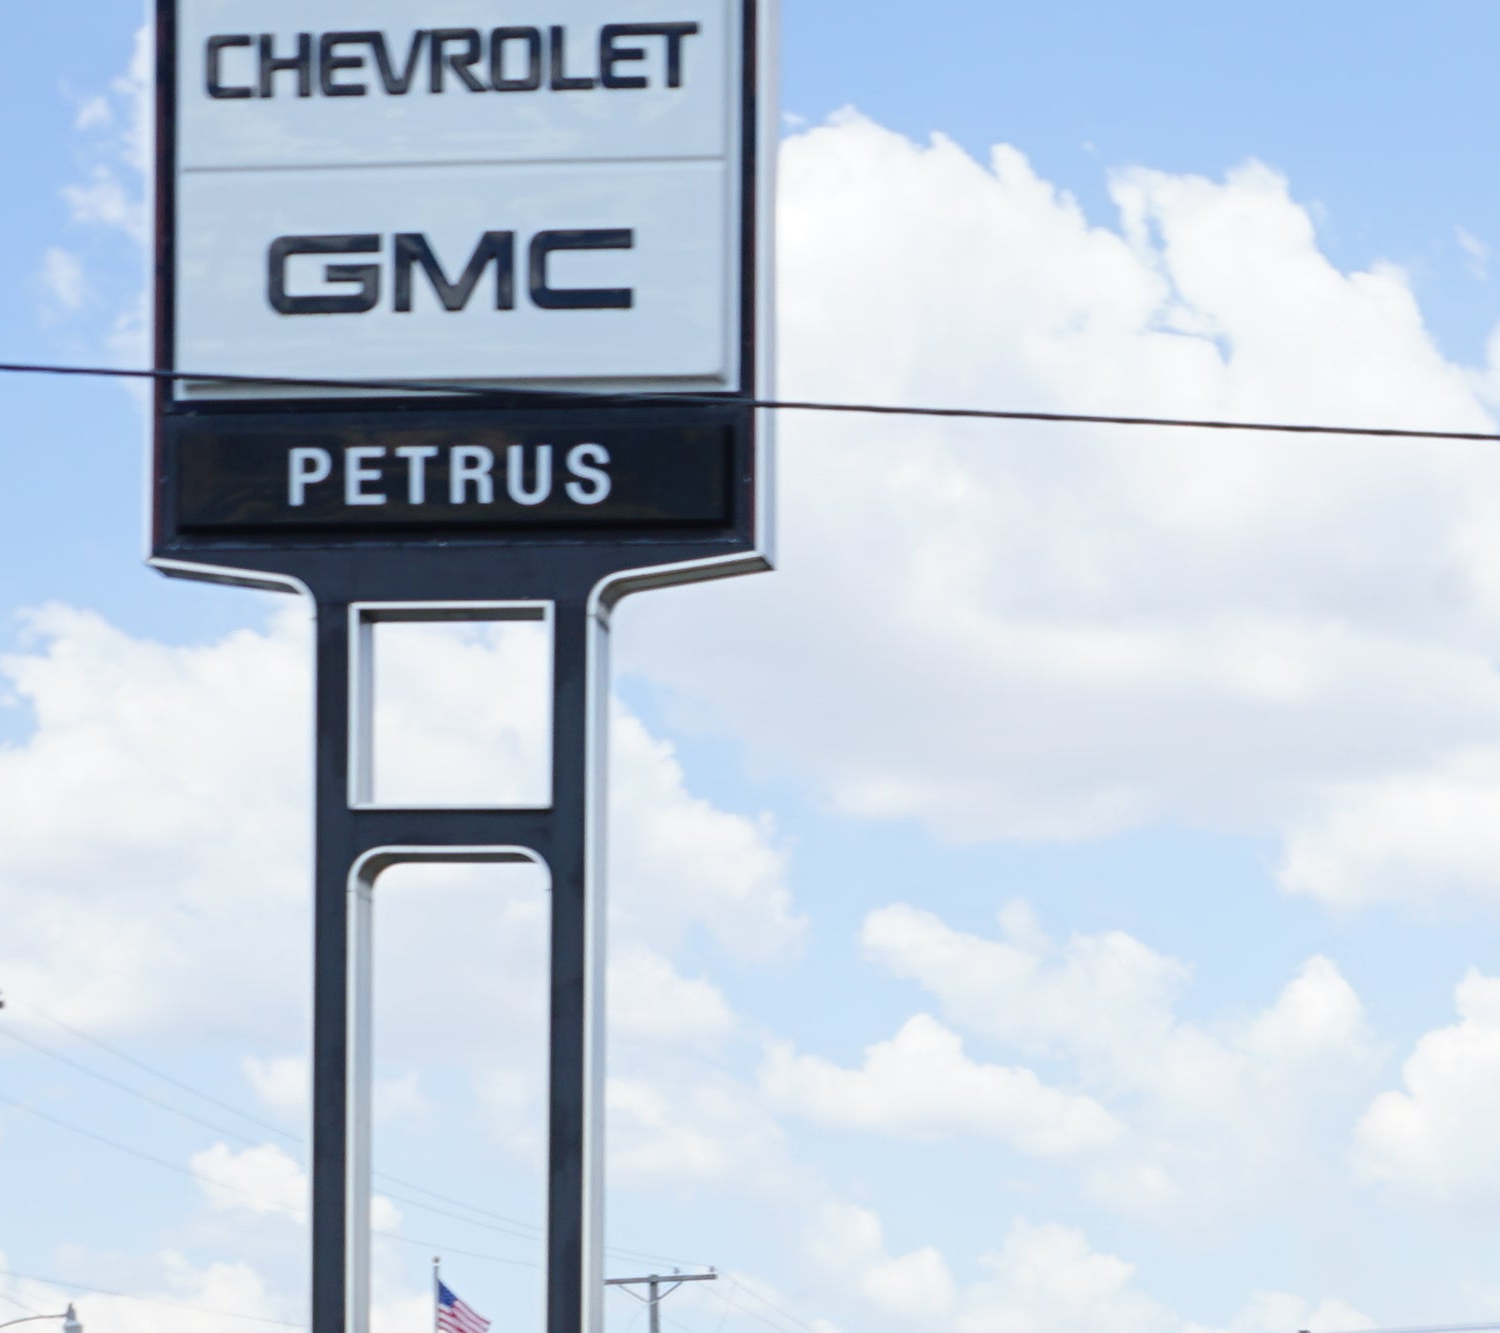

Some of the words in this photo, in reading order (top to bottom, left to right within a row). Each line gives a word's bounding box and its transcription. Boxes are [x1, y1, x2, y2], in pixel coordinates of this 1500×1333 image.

[205, 22, 700, 100] CHEVROLET
[267, 228, 635, 315] GMC
[287, 443, 613, 507] PETRUS
